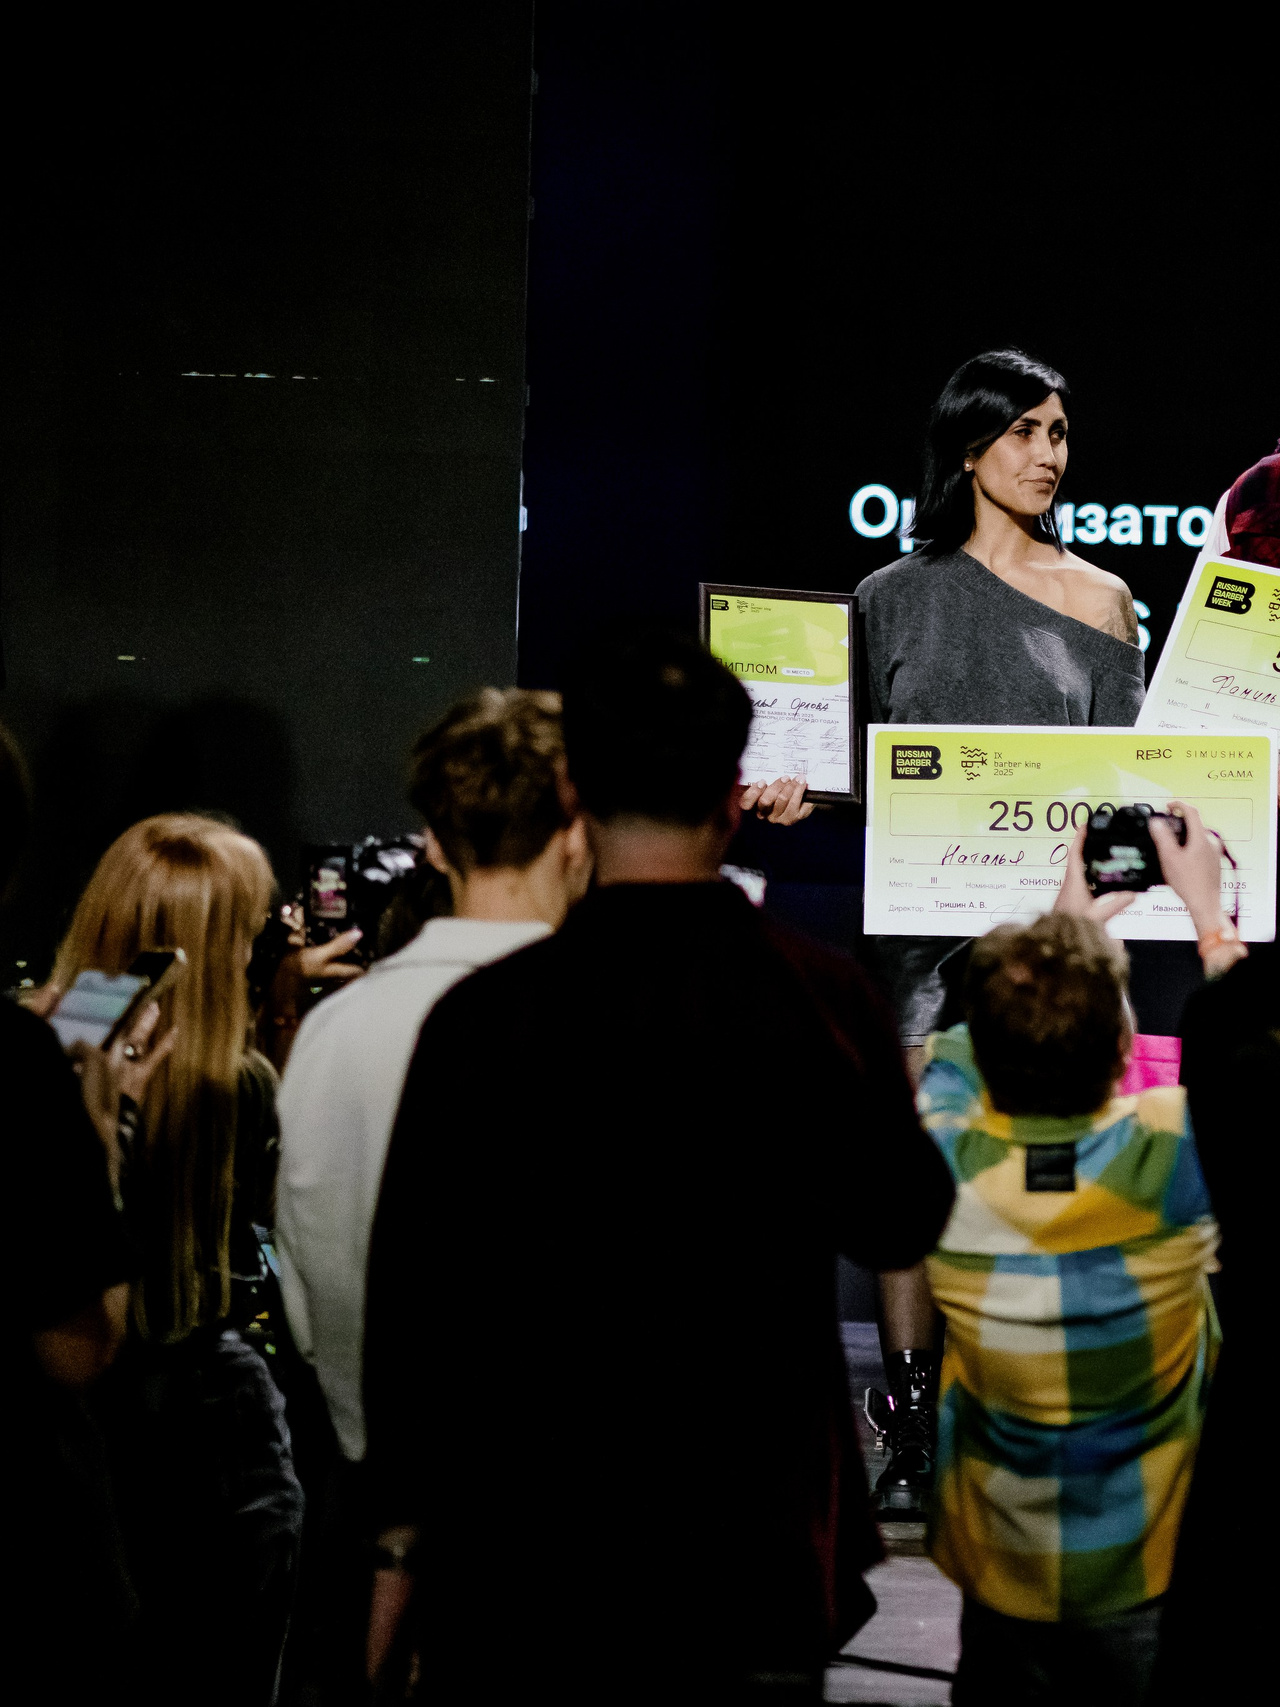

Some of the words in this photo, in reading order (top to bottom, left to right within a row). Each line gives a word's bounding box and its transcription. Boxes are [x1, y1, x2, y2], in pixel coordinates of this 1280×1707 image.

[1216, 581, 1248, 595] RUSSIAN
[1213, 590, 1244, 602] BARBER
[1211, 596, 1233, 608] WEEK
[1175, 677, 1189, 686] Имя
[1166, 698, 1188, 709] Место
[1232, 713, 1268, 727] Номинация
[896, 750, 932, 759] RUSSIAN
[994, 752, 1003, 760] IX
[1186, 750, 1254, 759] SIMUSHKA
[896, 758, 932, 767] BARBER
[994, 760, 1022, 768] barber
[1024, 760, 1042, 769] king
[896, 766, 921, 775] WEEK
[993, 768, 1014, 776] 2025
[988, 800, 1034, 832] 25
[889, 856, 905, 864] Имя
[888, 880, 914, 888] Место
[966, 882, 1006, 890] Номинация
[1019, 878, 1062, 886] ЮНИОРЫ
[888, 904, 925, 913] Директор
[934, 900, 966, 910] Тришин
[1152, 904, 1188, 912] Иванова
